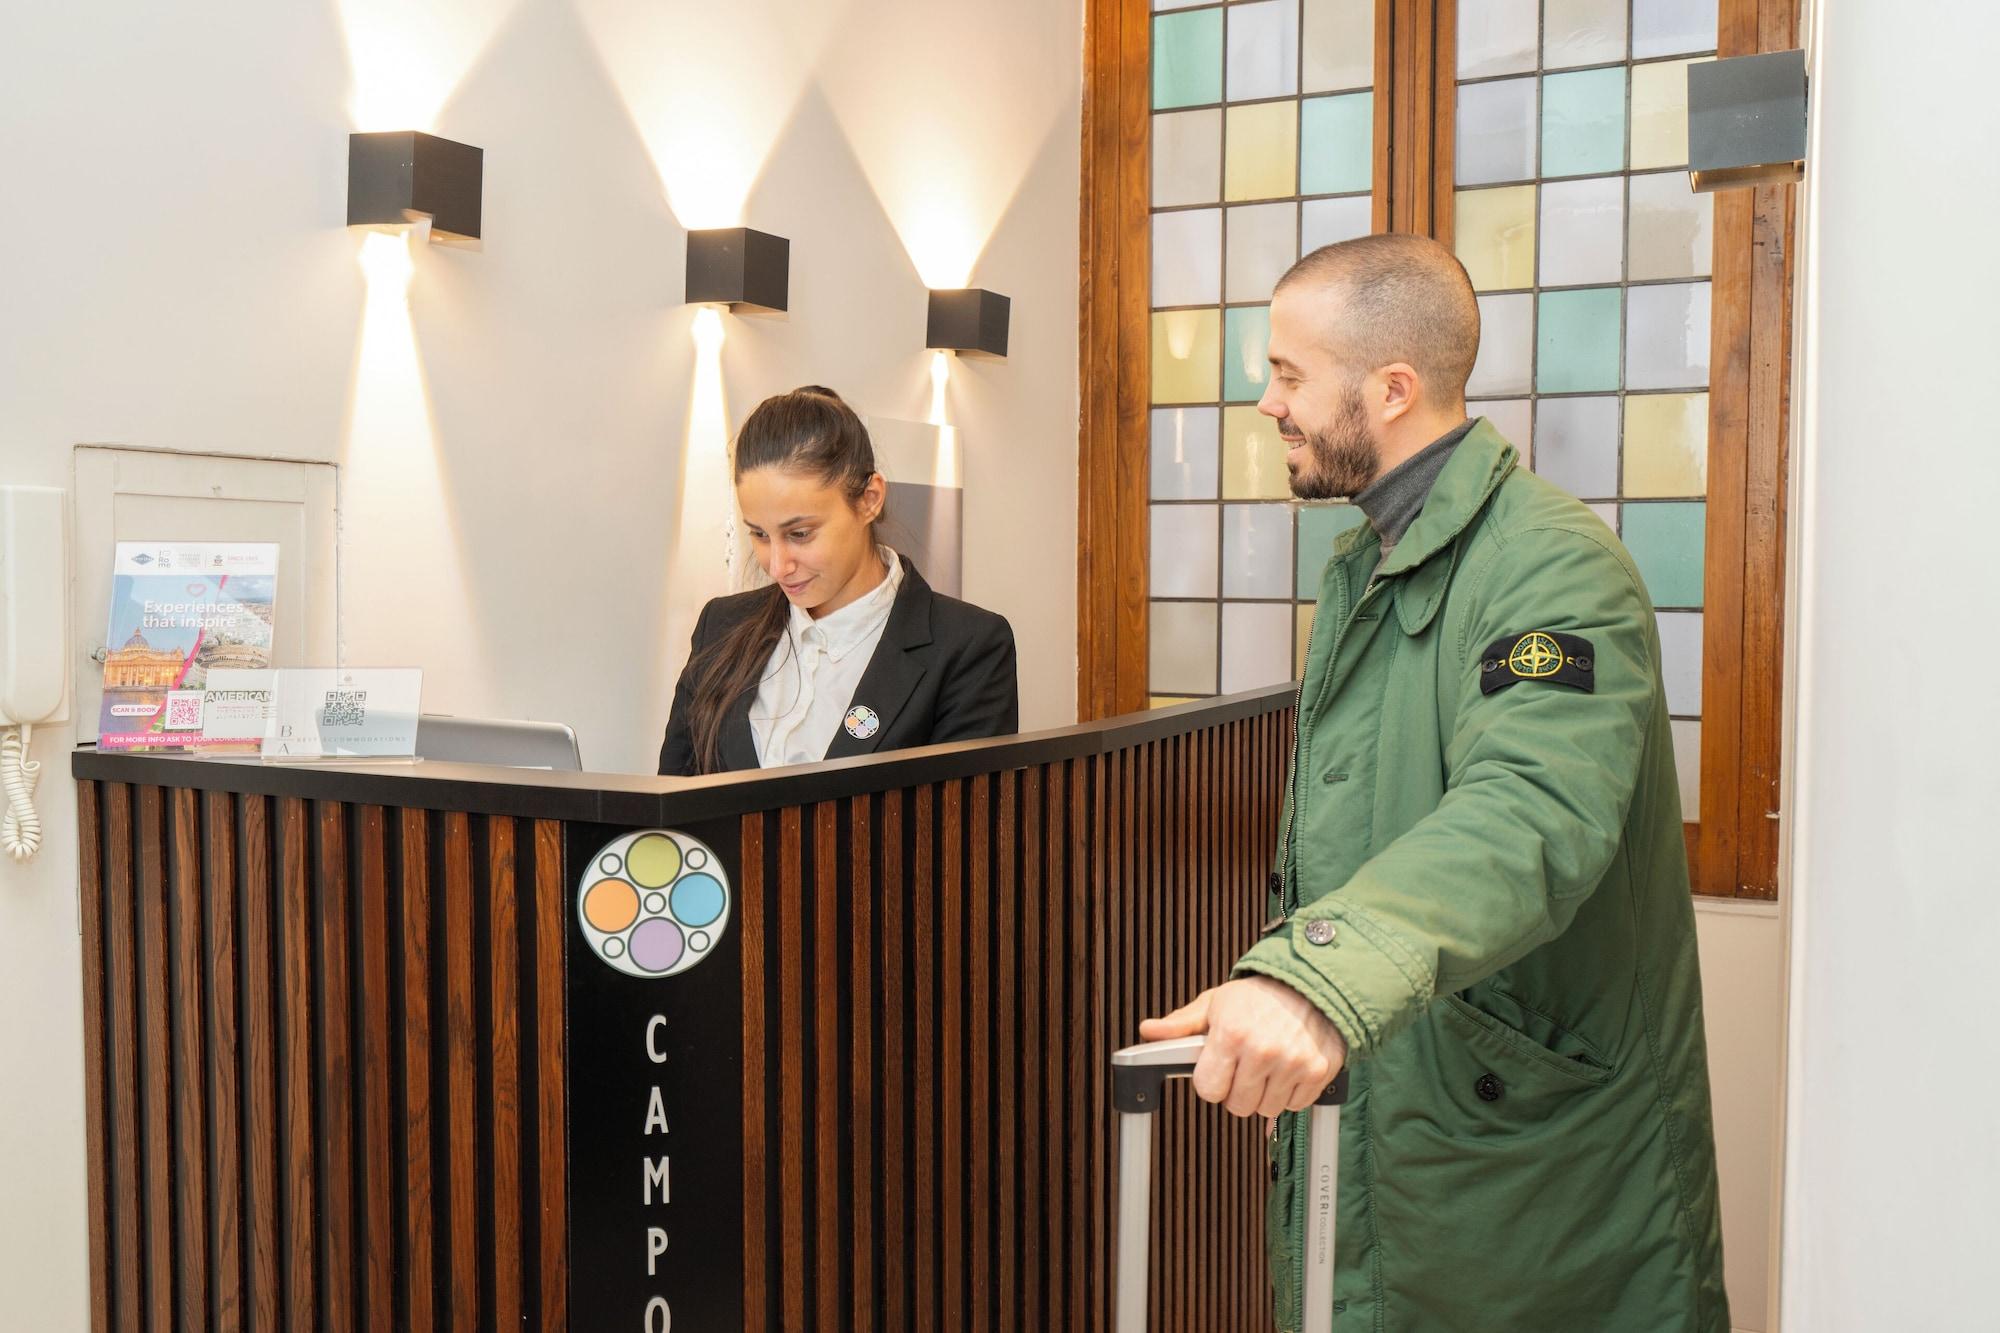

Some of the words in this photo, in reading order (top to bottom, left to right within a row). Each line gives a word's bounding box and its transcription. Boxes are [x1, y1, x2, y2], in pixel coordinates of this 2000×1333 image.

[144, 601, 244, 614] Experiences
[143, 615, 176, 628] that
[181, 615, 236, 629] inspire
[205, 690, 272, 702] AMERICAN
[281, 725, 292, 737] B
[643, 1014, 672, 1333] CAMPO
[1320, 1164, 1329, 1215] COVERI
[1319, 1217, 1327, 1265] COLLECTION
